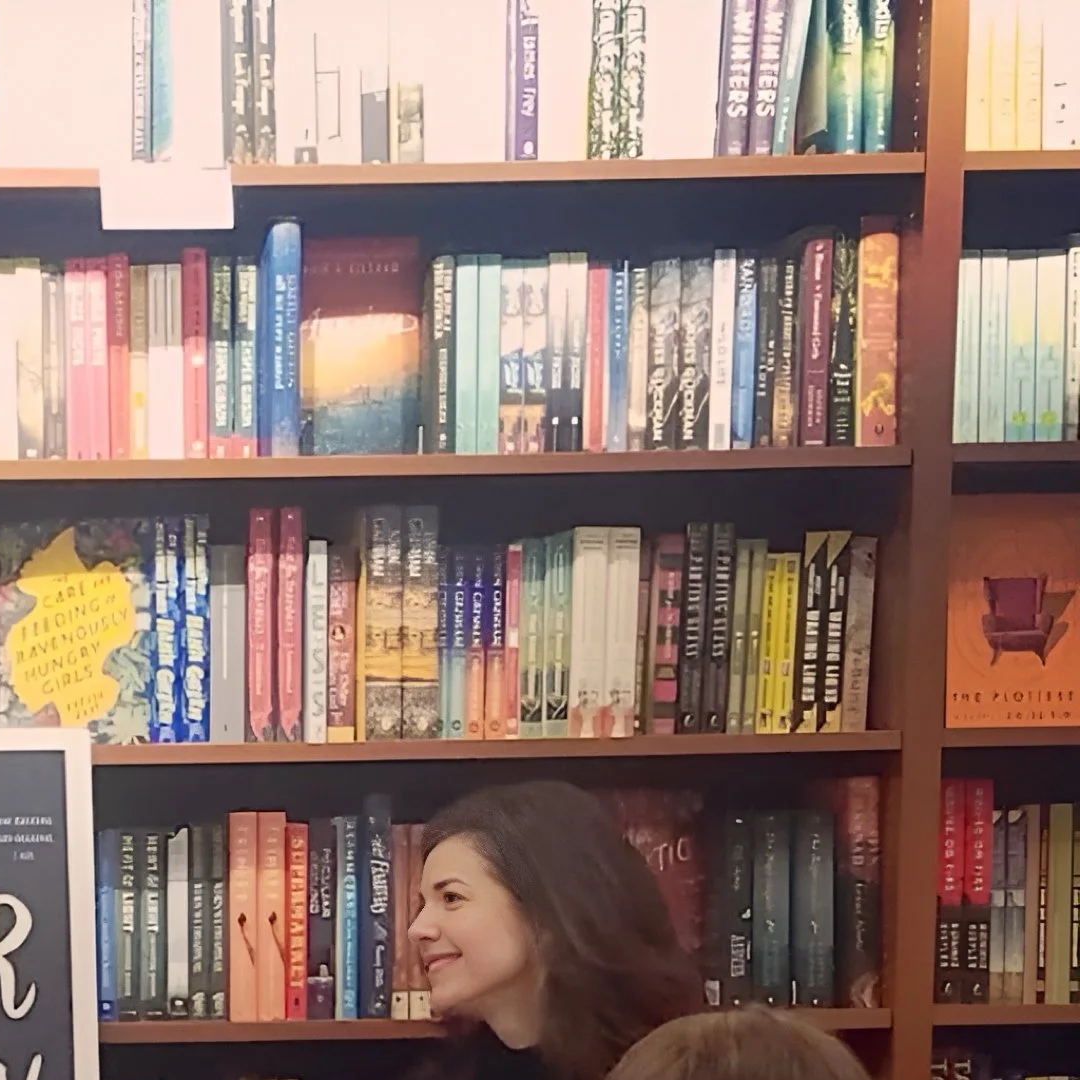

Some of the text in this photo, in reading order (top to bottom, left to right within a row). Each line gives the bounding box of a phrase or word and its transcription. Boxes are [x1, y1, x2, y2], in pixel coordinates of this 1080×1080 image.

[726, 10, 757, 119] WINTERS
[755, 12, 785, 118] WINTERS
[42, 580, 85, 608] CARE
[16, 608, 128, 664] RAVENOUSLY
[25, 641, 100, 683] HUNGRY
[41, 664, 94, 695] GIRLS
